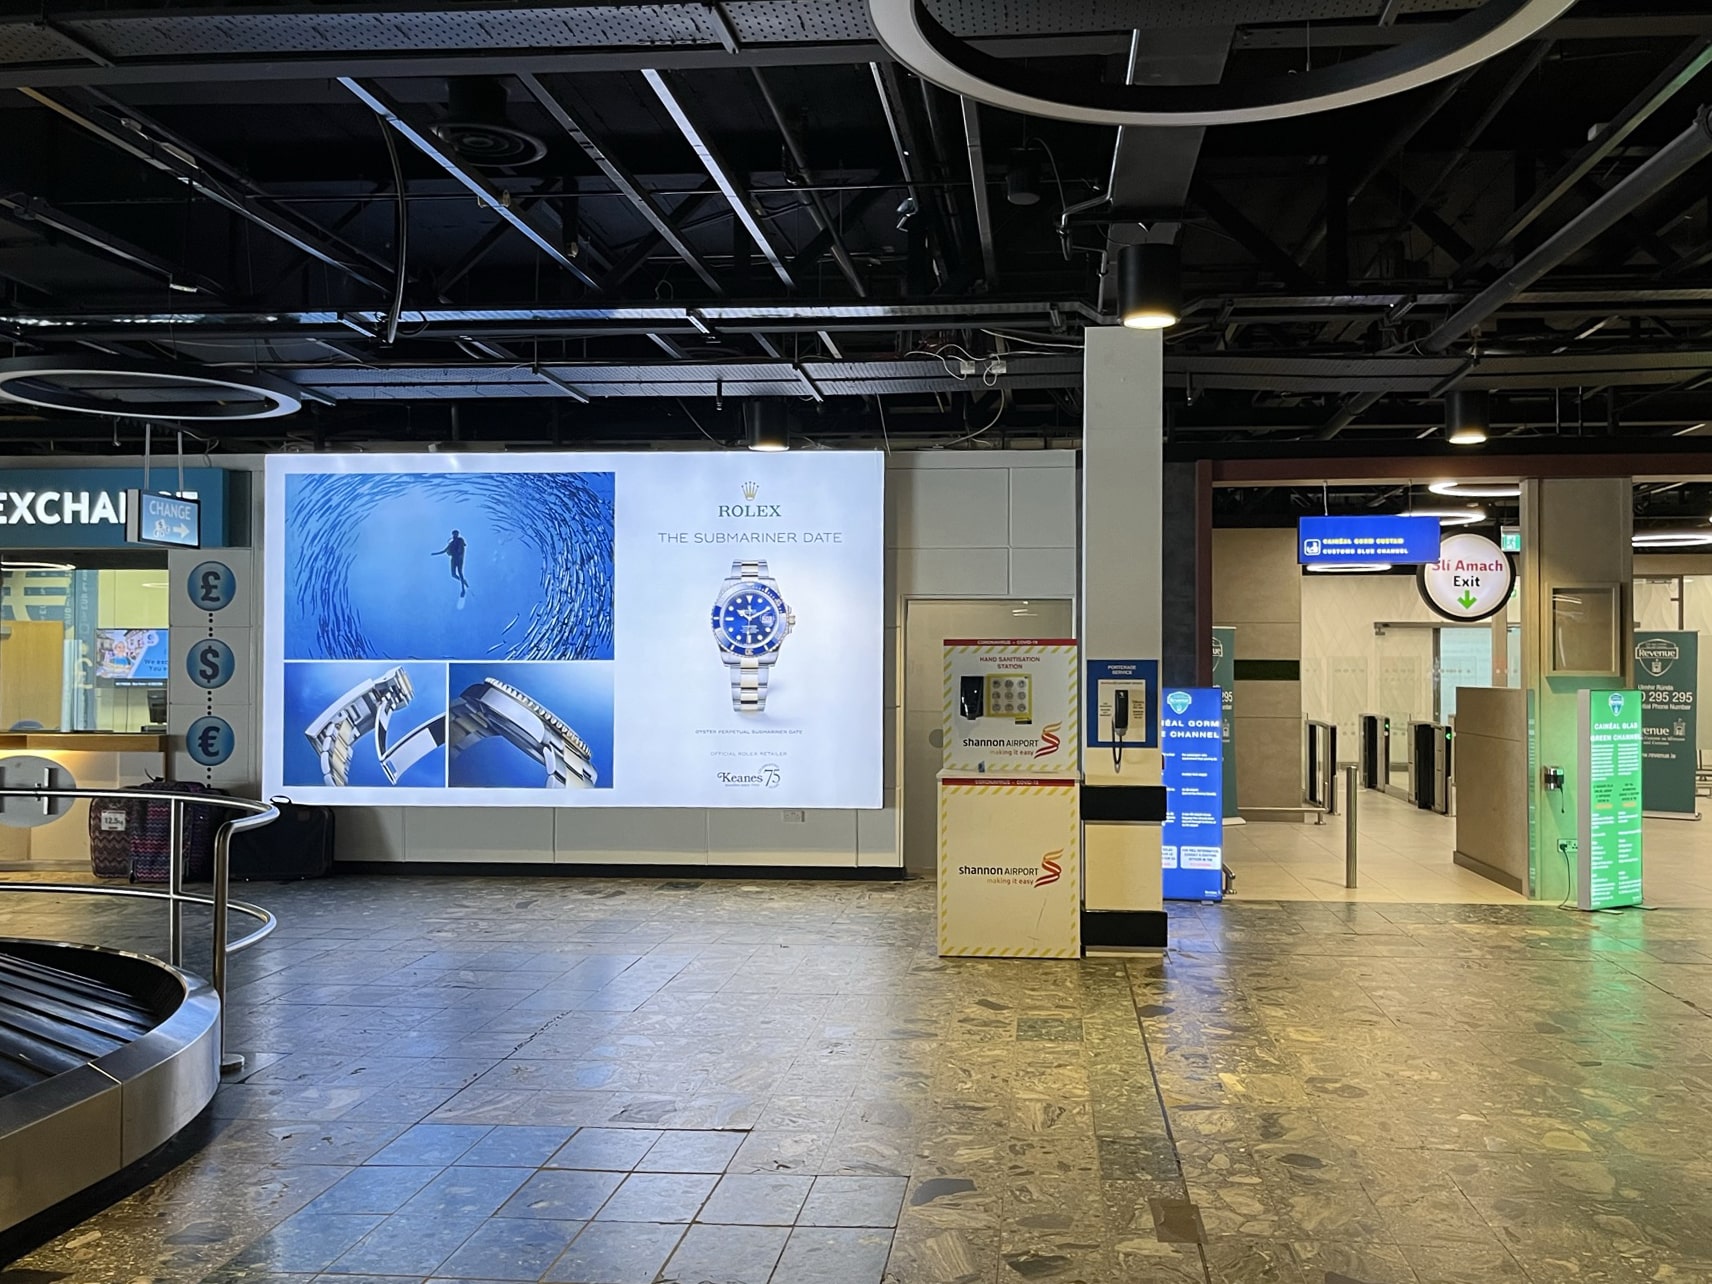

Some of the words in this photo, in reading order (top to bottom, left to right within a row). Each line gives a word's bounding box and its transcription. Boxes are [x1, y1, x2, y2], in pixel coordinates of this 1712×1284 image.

[150, 500, 192, 521] CHANGE
[718, 504, 781, 517] ROLEX
[658, 532, 689, 544] THE
[694, 532, 798, 544] SUBMARINER
[803, 532, 843, 544] DATE
[1455, 560, 1503, 572] Amach
[1453, 575, 1481, 587] Exit
[1639, 648, 1676, 657] Revenue
[1648, 691, 1669, 702] 295
[1672, 692, 1693, 703] 295
[1188, 720, 1220, 728] GORM
[1170, 731, 1220, 739] CHANNEL
[962, 738, 1005, 747] shannon
[1005, 739, 1039, 748] AIRPORT
[716, 771, 763, 783] Keanes
[763, 768, 781, 787] 75
[958, 865, 1003, 875] shannon
[1004, 867, 1039, 876] AIRPORT
[1018, 878, 1034, 886] easy
